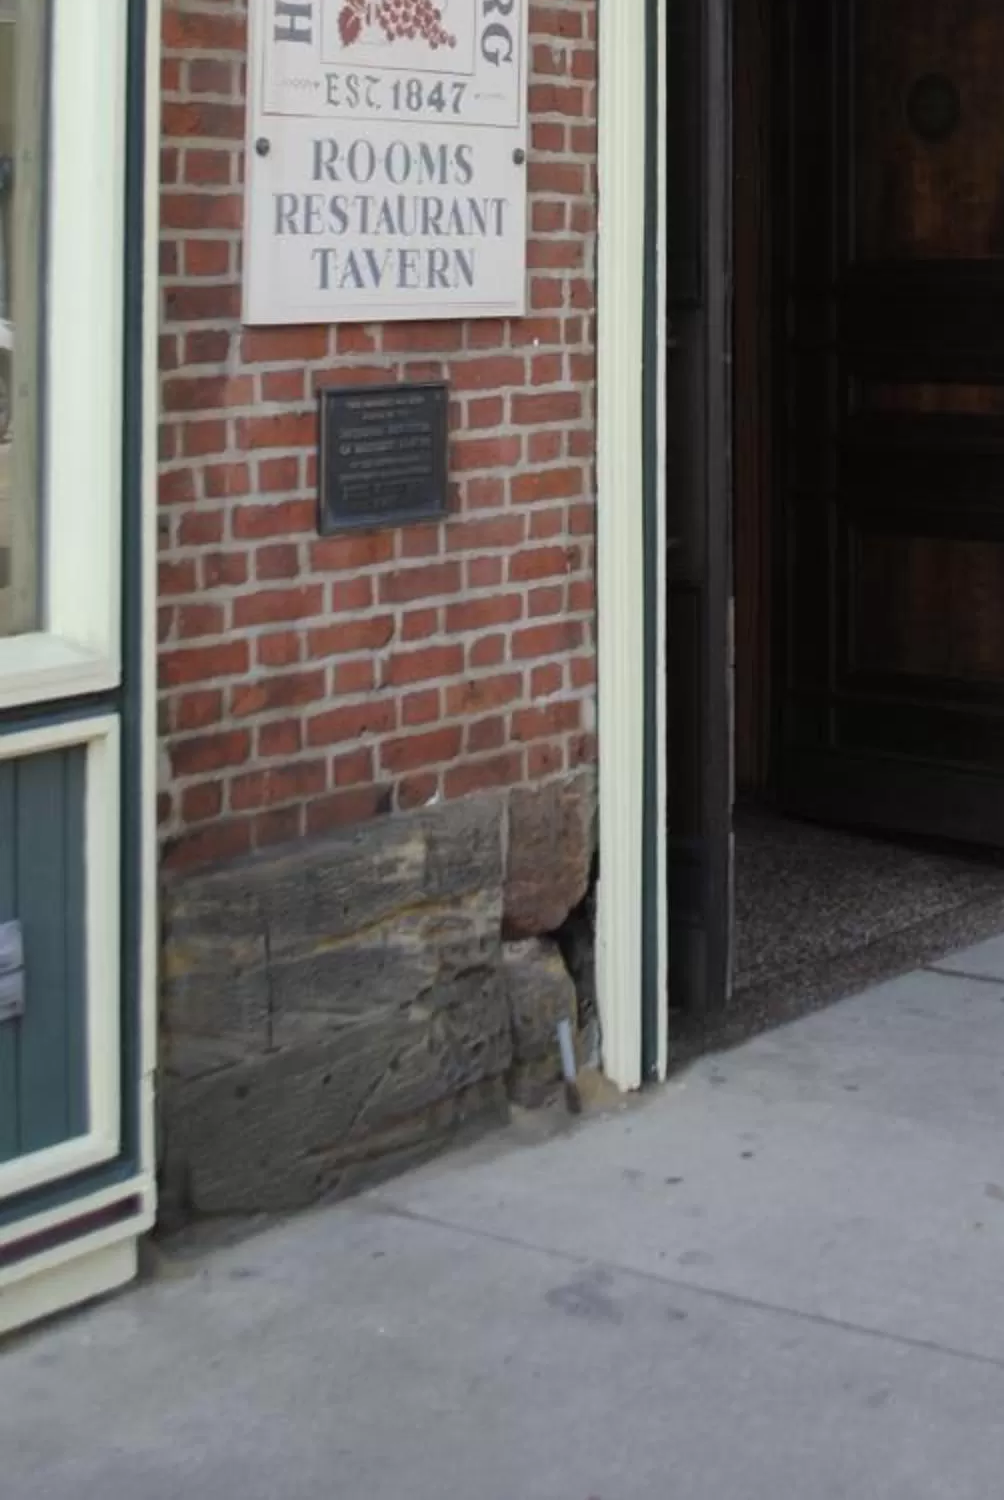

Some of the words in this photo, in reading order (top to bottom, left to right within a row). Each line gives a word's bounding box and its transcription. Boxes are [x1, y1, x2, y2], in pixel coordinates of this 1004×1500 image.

[391, 77, 467, 115] 1847
[311, 136, 475, 186] ROOMS
[272, 192, 510, 237] RESTAURANT
[311, 247, 476, 290] TAVERN
